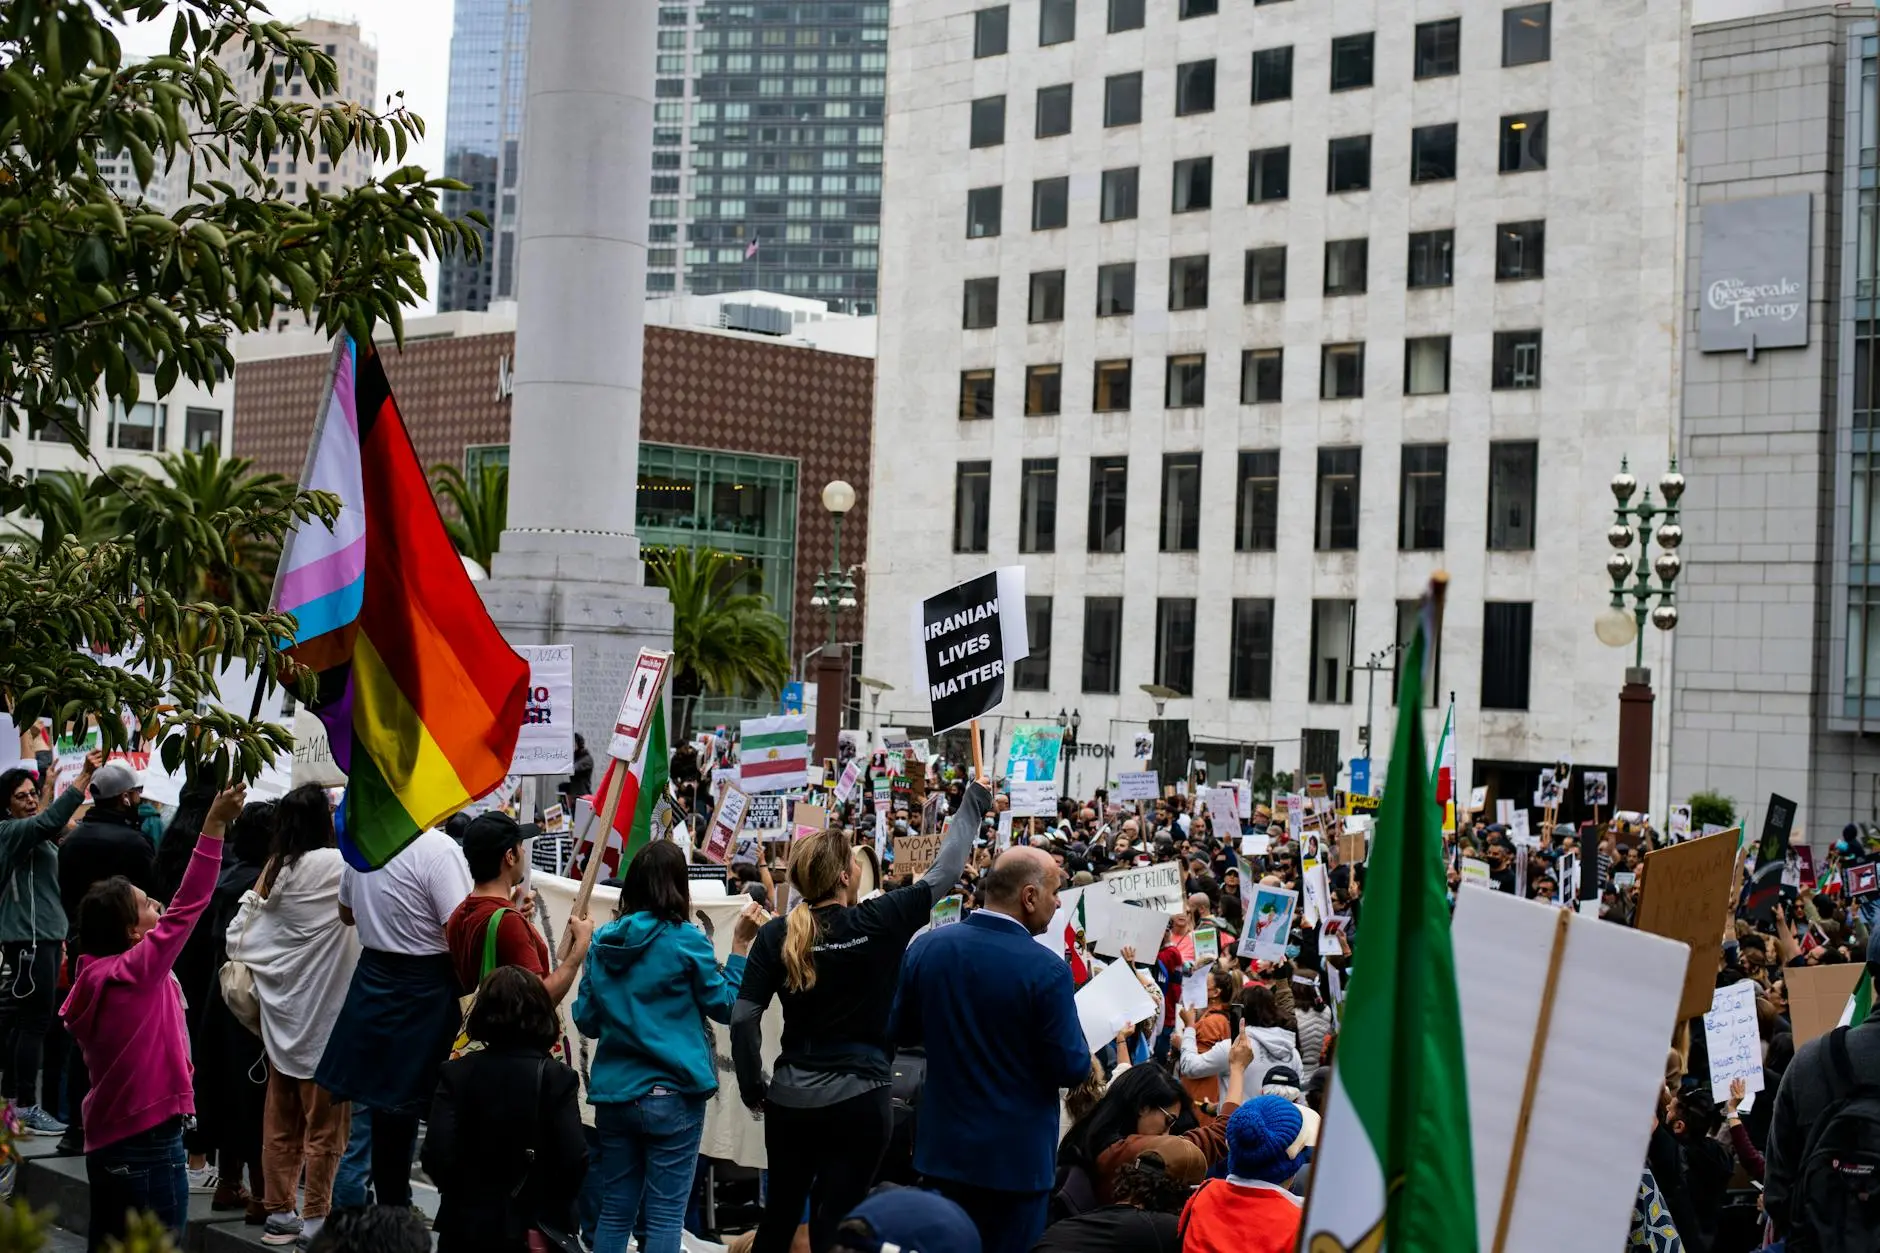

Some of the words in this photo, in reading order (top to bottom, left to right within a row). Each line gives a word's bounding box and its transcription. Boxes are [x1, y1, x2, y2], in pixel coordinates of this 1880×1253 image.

[1707, 277, 1800, 310] Cheesecake
[1733, 302, 1800, 326] Factory
[924, 598, 999, 641] IRANIAN
[938, 633, 990, 667] LIVES
[931, 660, 1004, 701] MATTER
[874, 791, 890, 799] LIVES
[898, 837, 942, 850] WOMA
[1108, 874, 1141, 894] STOP
